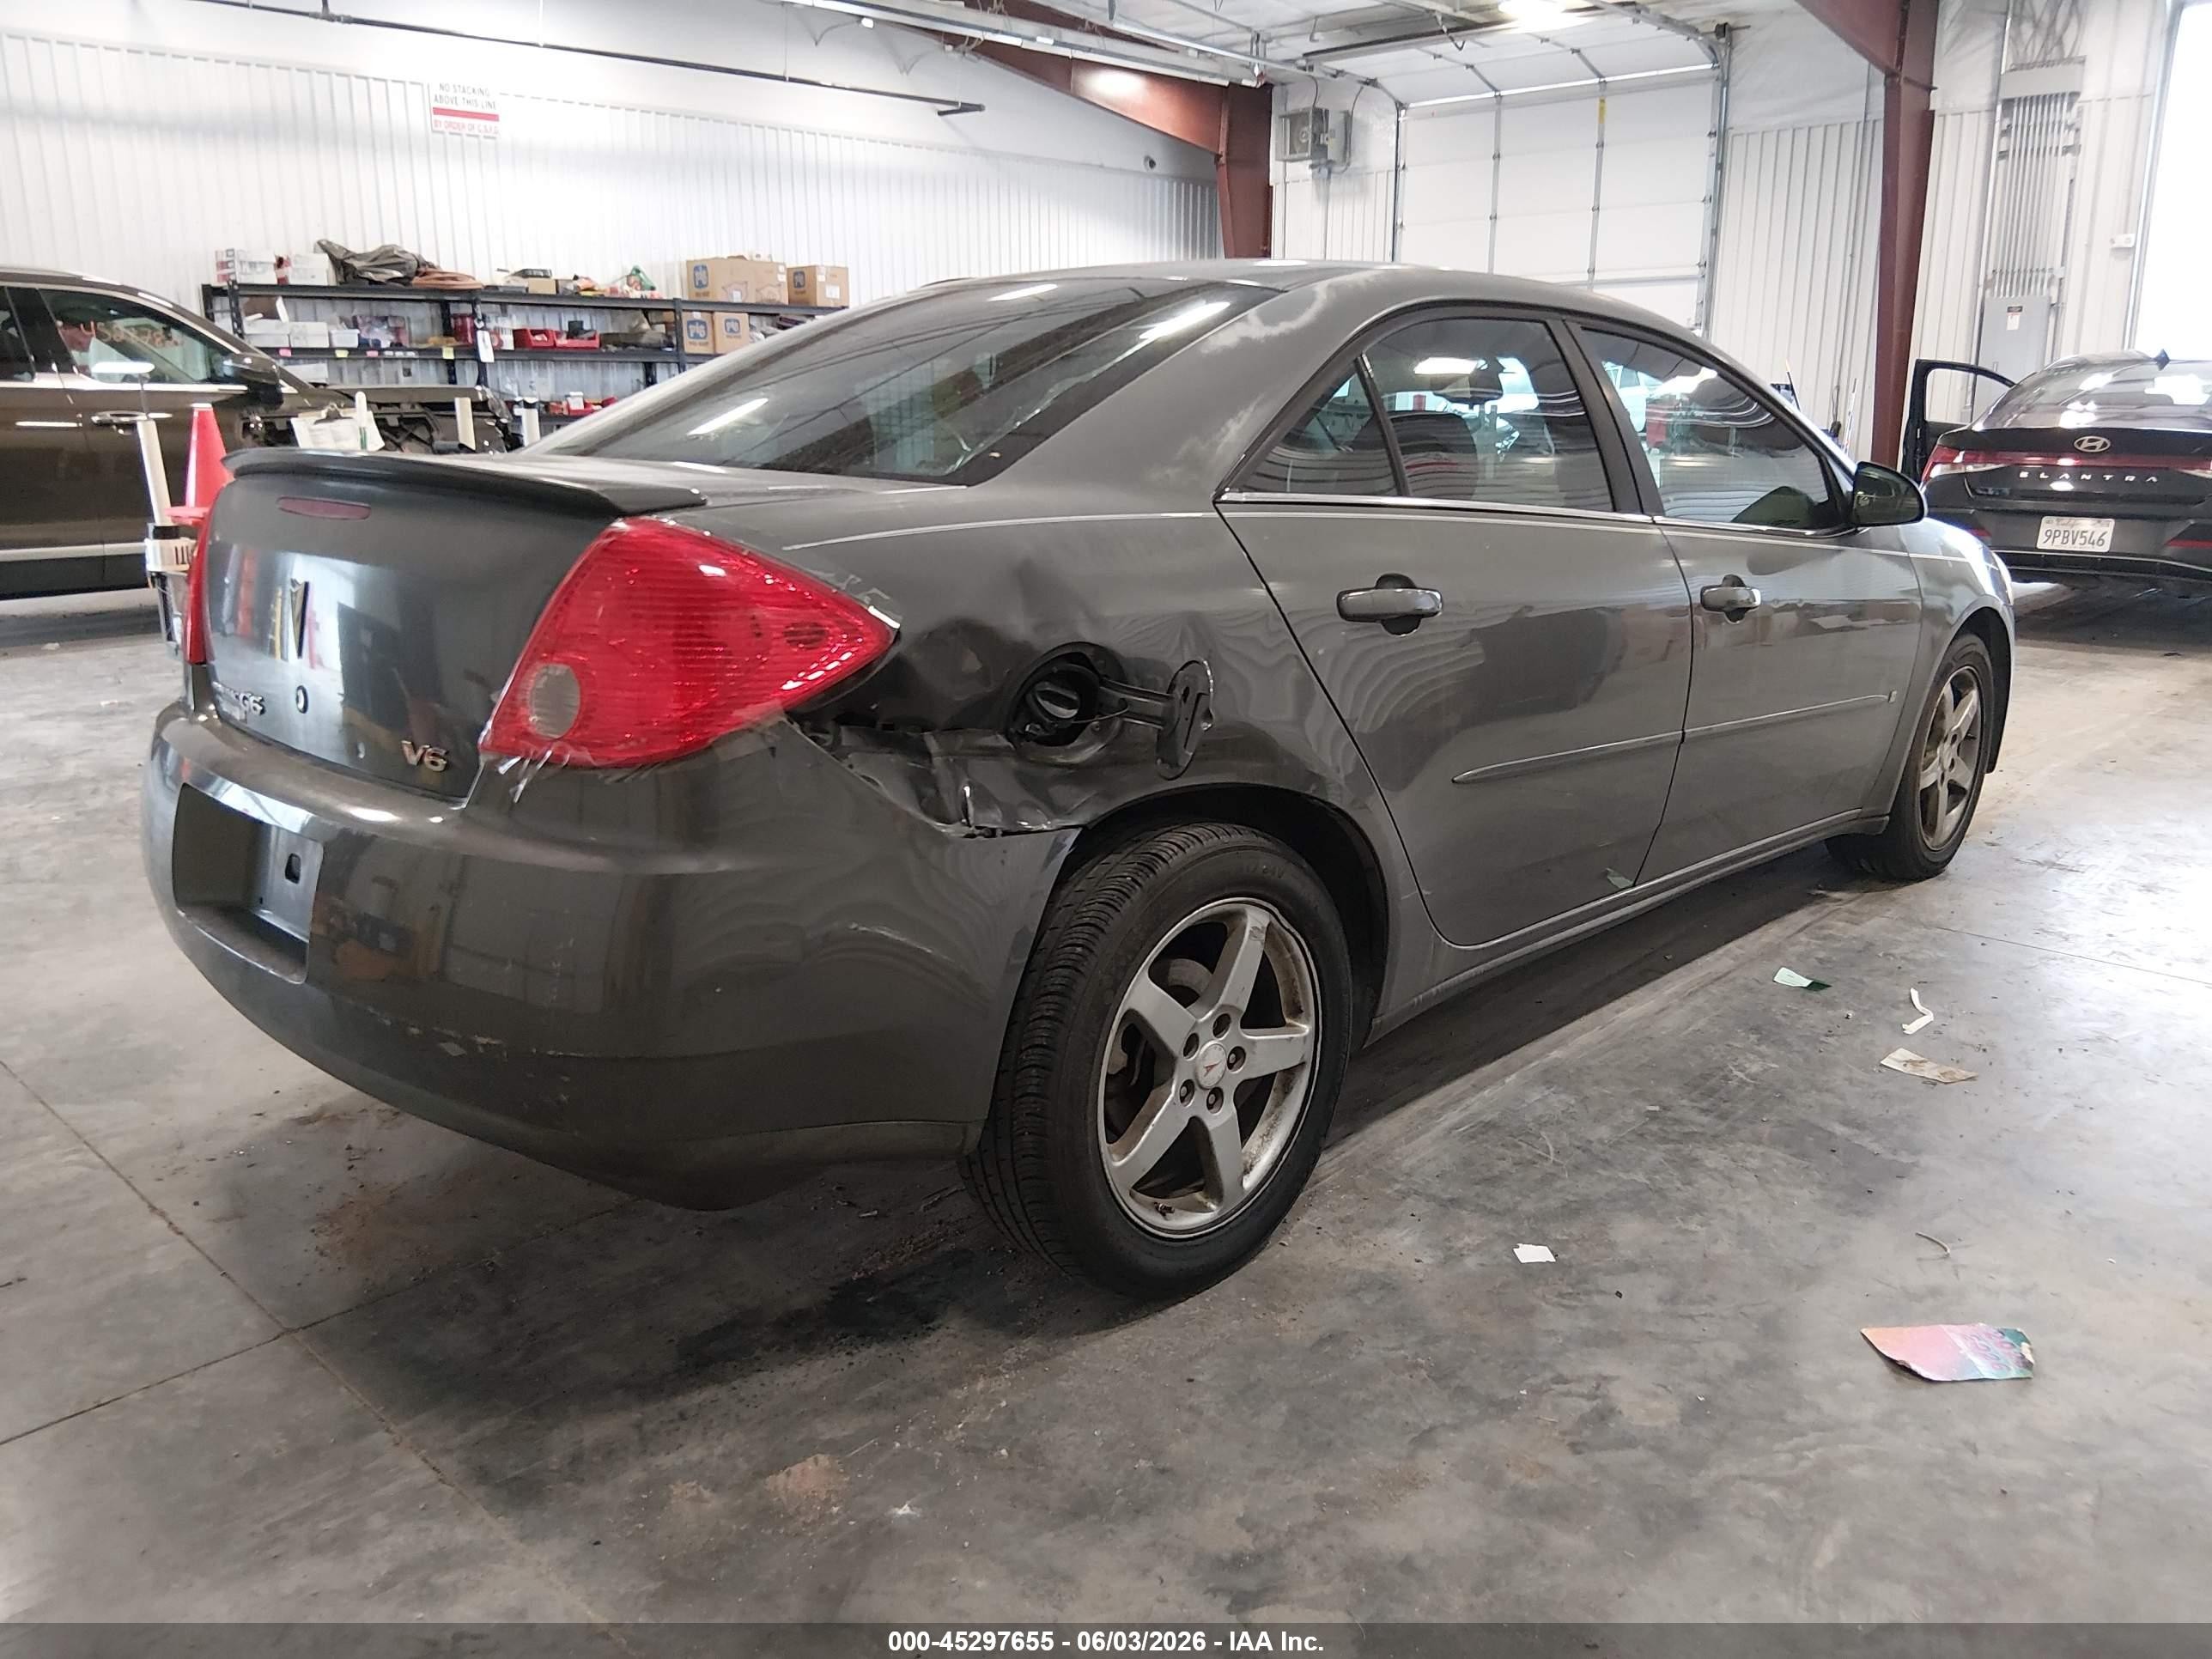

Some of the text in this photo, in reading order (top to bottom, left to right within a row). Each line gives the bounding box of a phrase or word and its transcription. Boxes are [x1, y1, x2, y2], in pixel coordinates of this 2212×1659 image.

[439, 82, 490, 97] NO STACKING
[434, 94, 496, 110] ABOVE THIS LINE
[2019, 471, 2158, 482] ELANTRA
[2043, 529, 2107, 547] 9PBV546
[401, 740, 447, 772] V6
